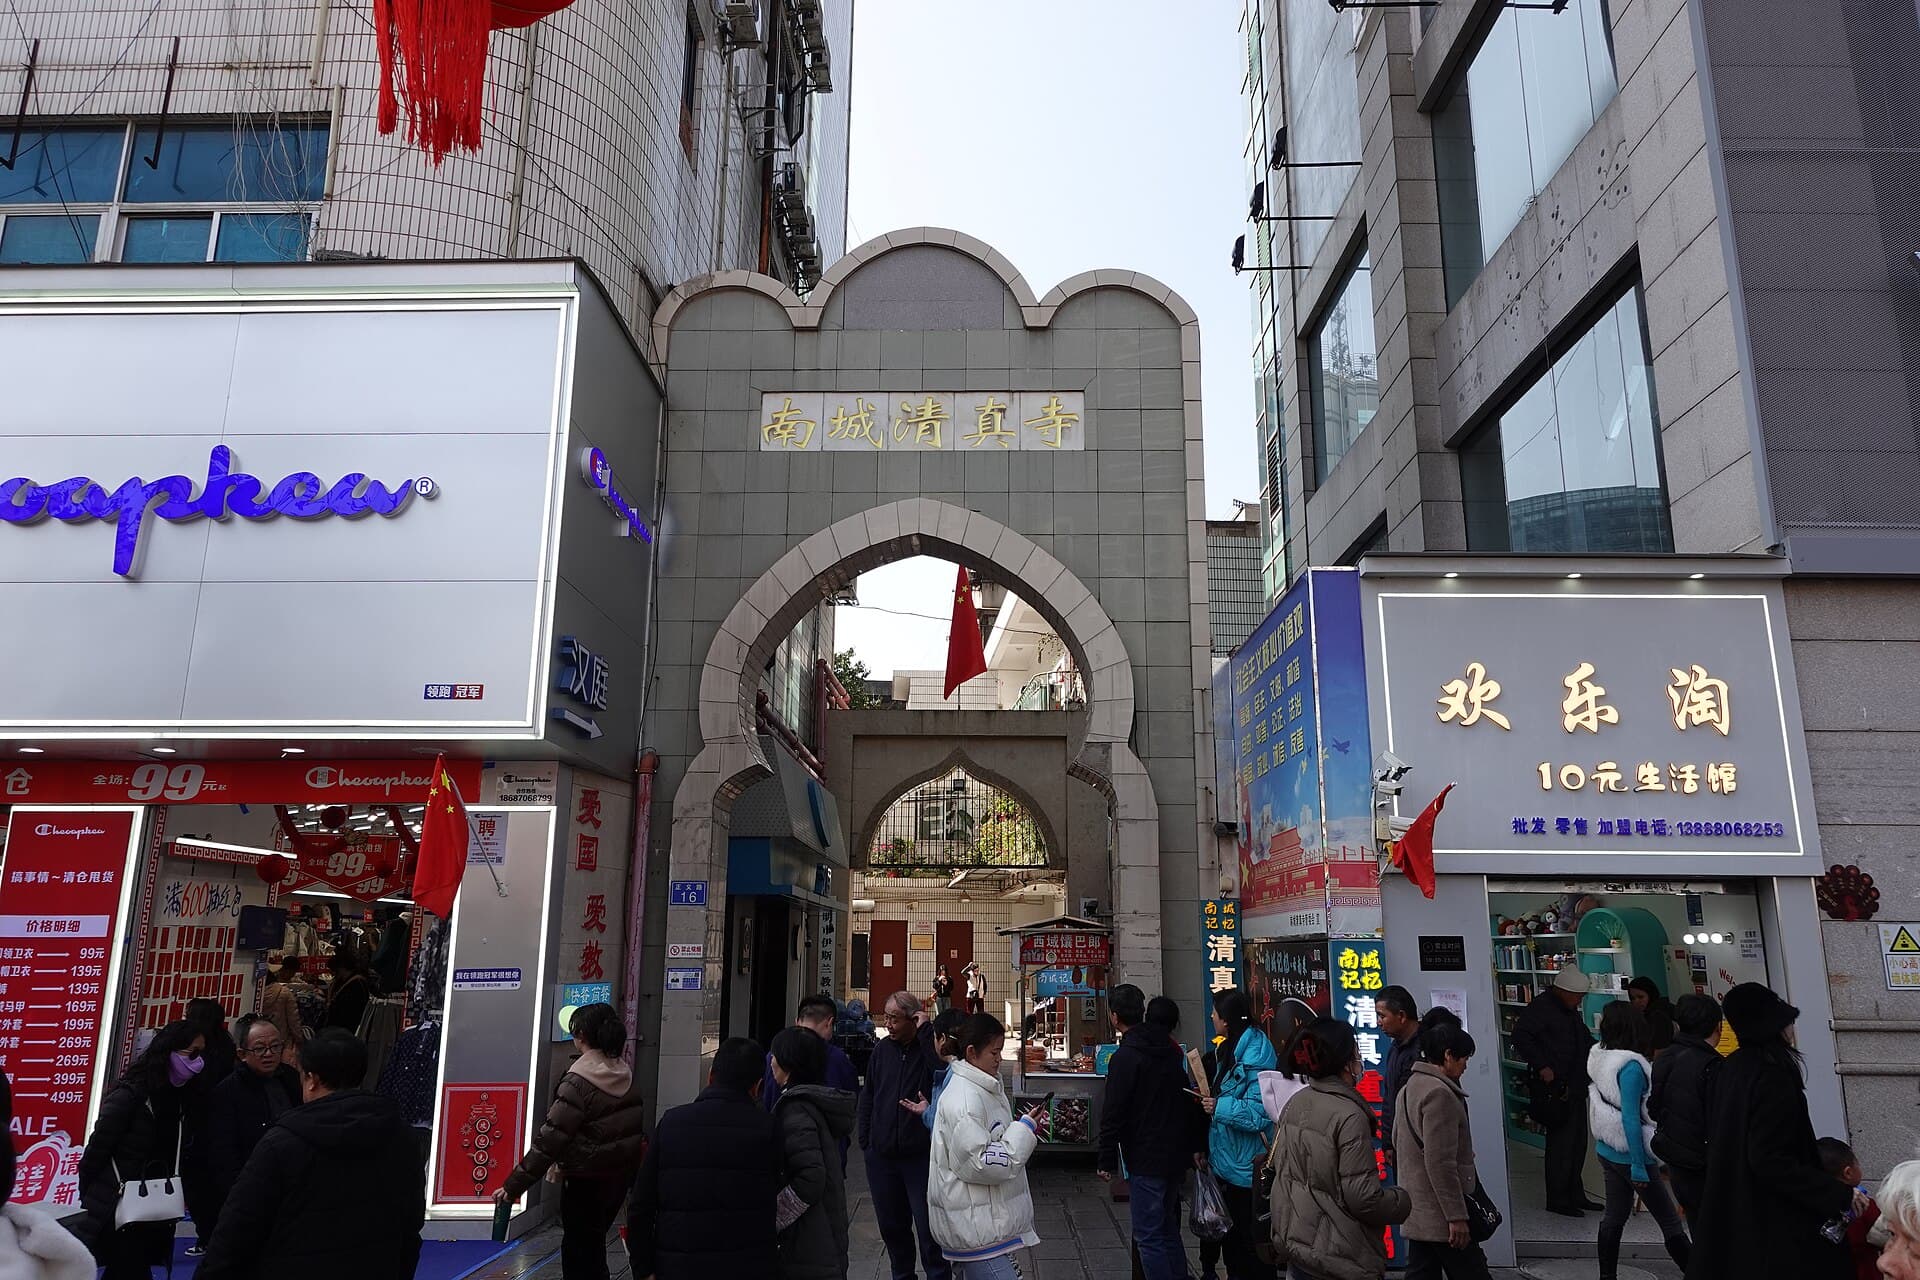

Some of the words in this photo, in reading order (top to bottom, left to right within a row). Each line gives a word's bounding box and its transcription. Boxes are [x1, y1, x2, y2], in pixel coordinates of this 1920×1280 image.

[762, 397, 1080, 448] 南城清真寺
[1235, 601, 1304, 696] 社会主义核心价值观
[568, 637, 609, 711] 汉庭
[427, 686, 451, 698] 领跑
[455, 686, 481, 698] 冠军
[1436, 662, 1731, 736] 欢乐淘
[5, 768, 33, 795] 仓
[1537, 761, 1738, 795] 10元生活馆
[478, 820, 496, 837] 聘
[575, 788, 602, 872] 爱国
[1512, 817, 1546, 835] 批发
[1555, 817, 1588, 835] 零售
[681, 891, 697, 903] 16
[1204, 901, 1237, 915] 南城
[26, 919, 81, 933] 价格明细
[1205, 917, 1236, 930] 记忆
[0, 948, 34, 959] 领卫衣
[79, 948, 105, 959] 99元
[1338, 947, 1381, 970] 南城
[71, 965, 102, 977] 139元
[1207, 934, 1238, 994] 清真
[1339, 969, 1383, 989] 记忆
[68, 983, 99, 994] 139元
[65, 1001, 97, 1012] 169元
[0, 1019, 23, 1031] 外套
[63, 1019, 94, 1030] 199元
[1344, 995, 1383, 1065] 清真
[58, 1036, 92, 1048] 269元
[56, 1055, 89, 1066] 269元
[53, 1073, 86, 1084] 399元
[50, 1091, 83, 1103] 499元
[53, 1181, 78, 1205] 新
